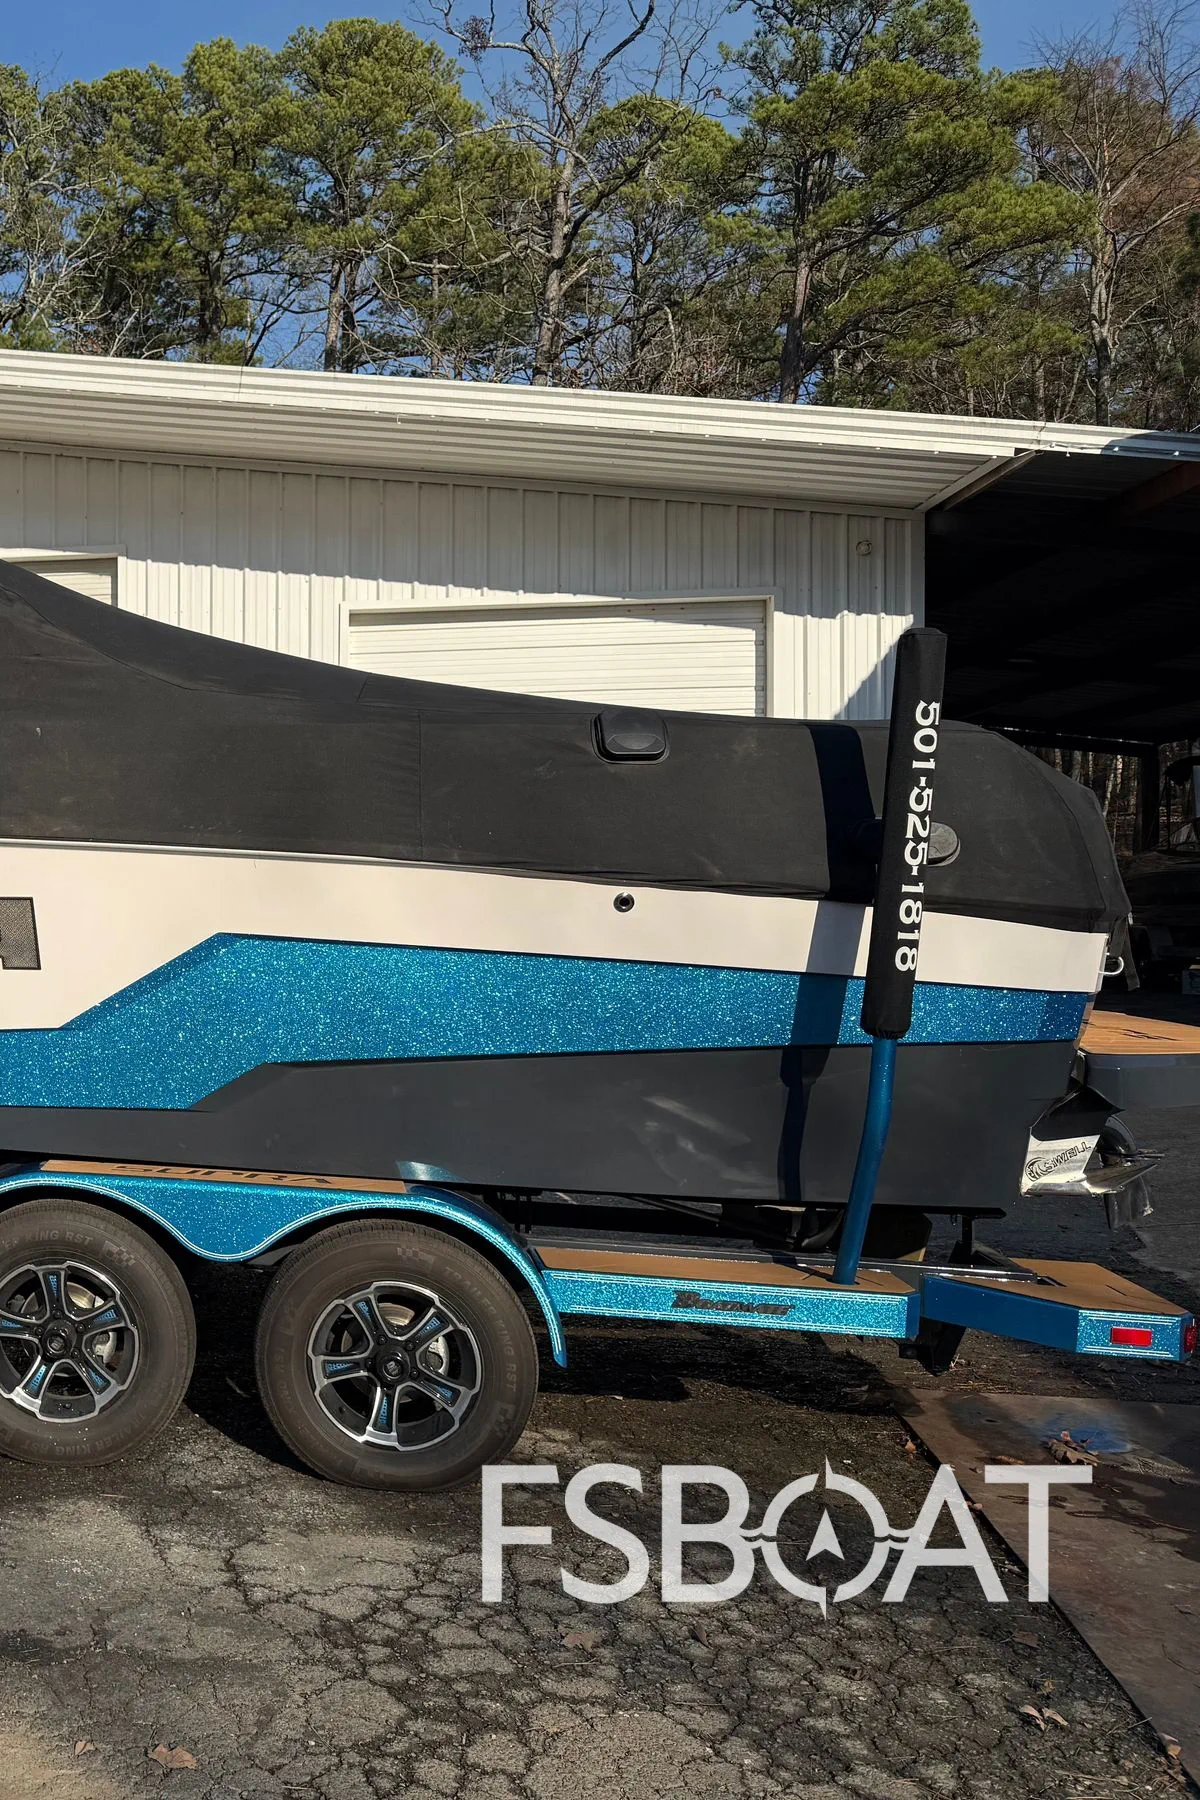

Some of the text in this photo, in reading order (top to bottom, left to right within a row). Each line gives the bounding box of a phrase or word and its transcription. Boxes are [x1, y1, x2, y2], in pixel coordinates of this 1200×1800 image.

[895, 700, 940, 972] 501-525-1818
[1043, 1141, 1092, 1172] SWELL
[111, 1165, 332, 1184] SUPRA
[65, 1230, 94, 1245] RST
[503, 1363, 518, 1392] RST
